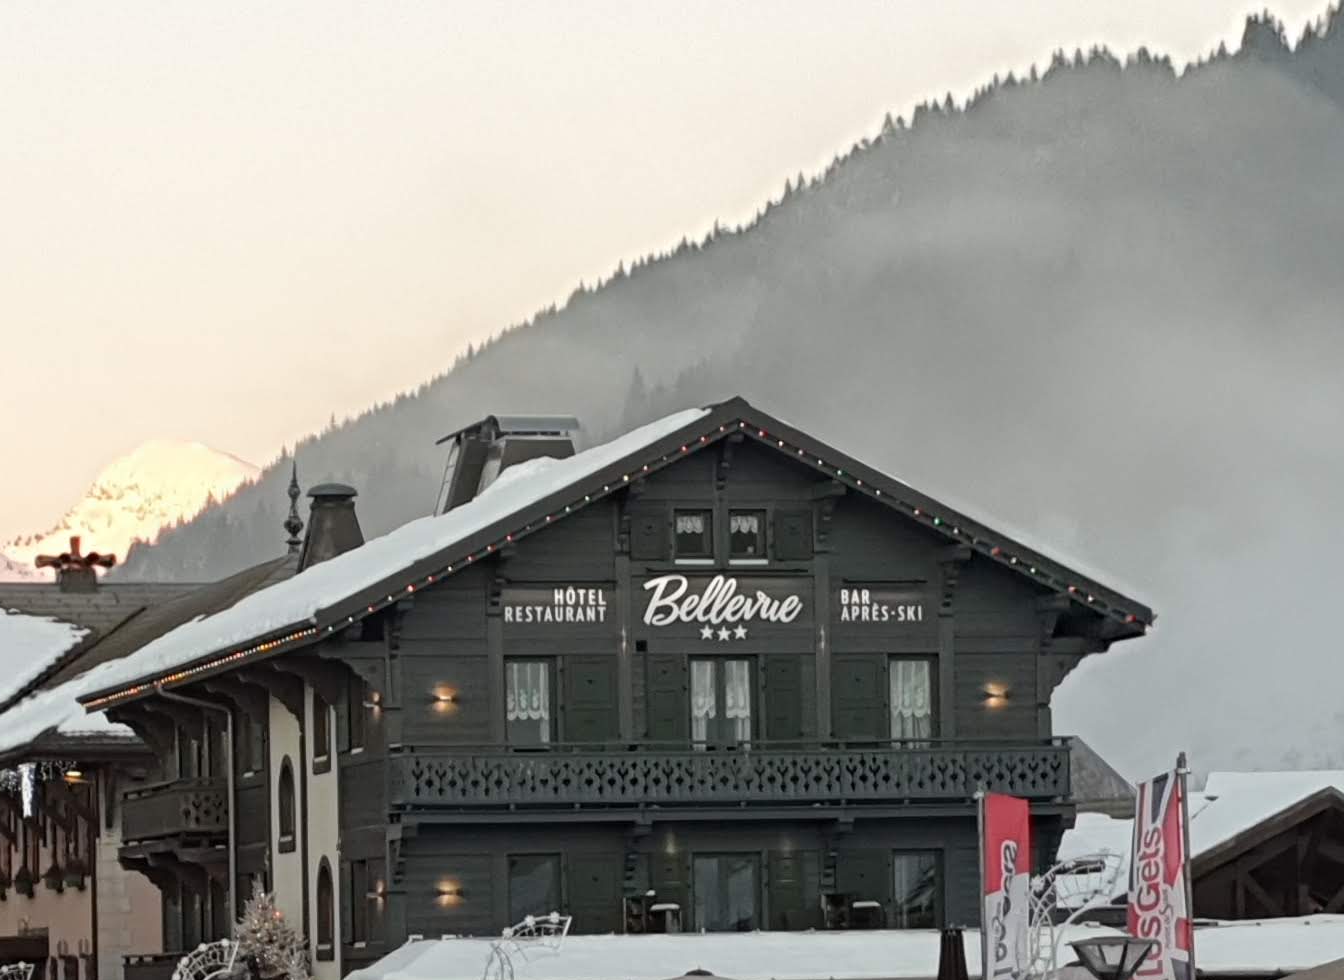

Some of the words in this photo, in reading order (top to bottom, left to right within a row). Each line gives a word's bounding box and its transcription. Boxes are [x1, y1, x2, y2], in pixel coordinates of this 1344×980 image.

[554, 586, 607, 605] HÔTEL
[642, 575, 803, 626] Bellevue
[840, 589, 871, 605] BAR
[504, 606, 607, 622] RESTAURANT
[840, 603, 923, 621] APRÈS-SKI
